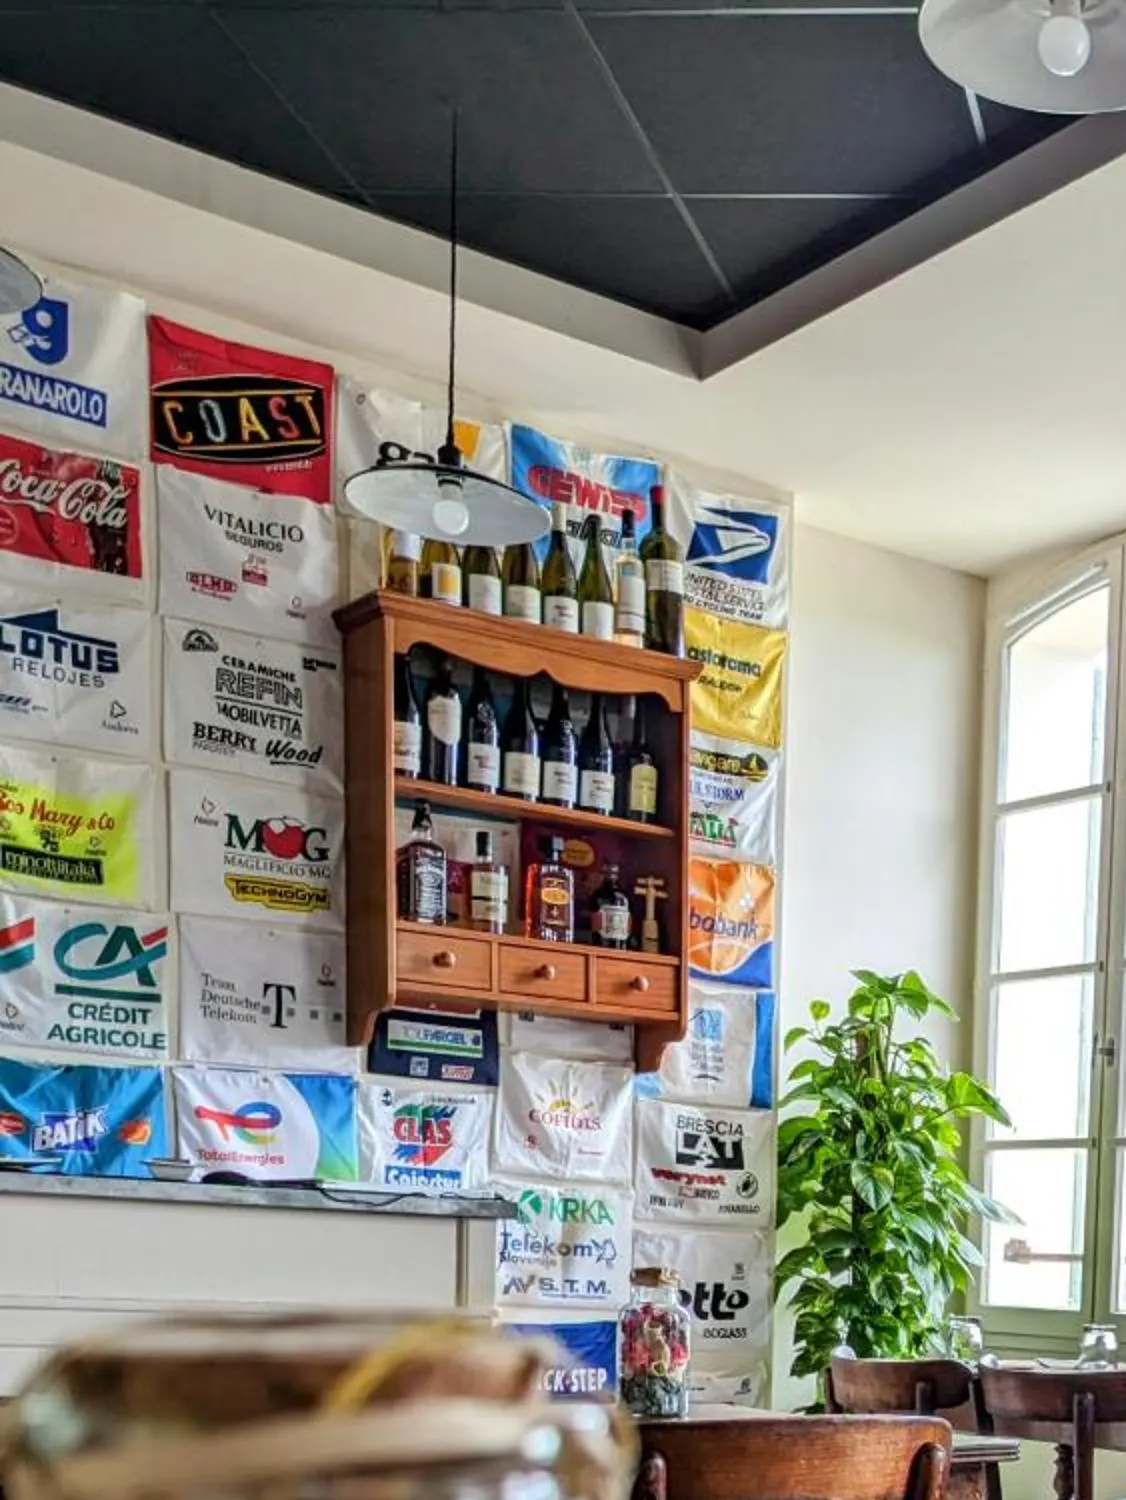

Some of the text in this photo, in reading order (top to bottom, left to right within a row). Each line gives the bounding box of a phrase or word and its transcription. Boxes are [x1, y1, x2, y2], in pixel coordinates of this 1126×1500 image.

[0, 367, 103, 421] RANAROLO
[163, 396, 321, 444] COAST
[203, 504, 305, 543] VITALICIO
[225, 529, 285, 553] SEGUROS
[0, 624, 119, 674] LOTUS
[686, 646, 761, 678] astorama
[12, 656, 105, 689] RELOJES
[222, 654, 297, 683] CERAMICHE
[215, 666, 303, 709] REFIN
[192, 720, 258, 753] BERRY
[216, 702, 303, 741] MOBILVETTA
[264, 738, 324, 765] Wood
[224, 854, 305, 877] MAGLIFICIO
[689, 905, 758, 939] bobank
[54, 922, 169, 988] CA
[201, 971, 237, 992] Team
[67, 1001, 153, 1025] CRÉDIT
[200, 988, 262, 1011] Deutsche
[200, 1003, 258, 1025] Telekom
[261, 981, 297, 1029] T
[47, 1023, 168, 1051] AGRICOLE
[394, 1118, 452, 1144] CLAS
[677, 1114, 744, 1137] BRESCIA
[195, 1149, 285, 1166] TotalEnergies
[678, 1131, 738, 1160] LAT
[549, 1196, 615, 1226] KRKA
[500, 1217, 593, 1259] Telekom
[677, 1281, 749, 1321] otto
